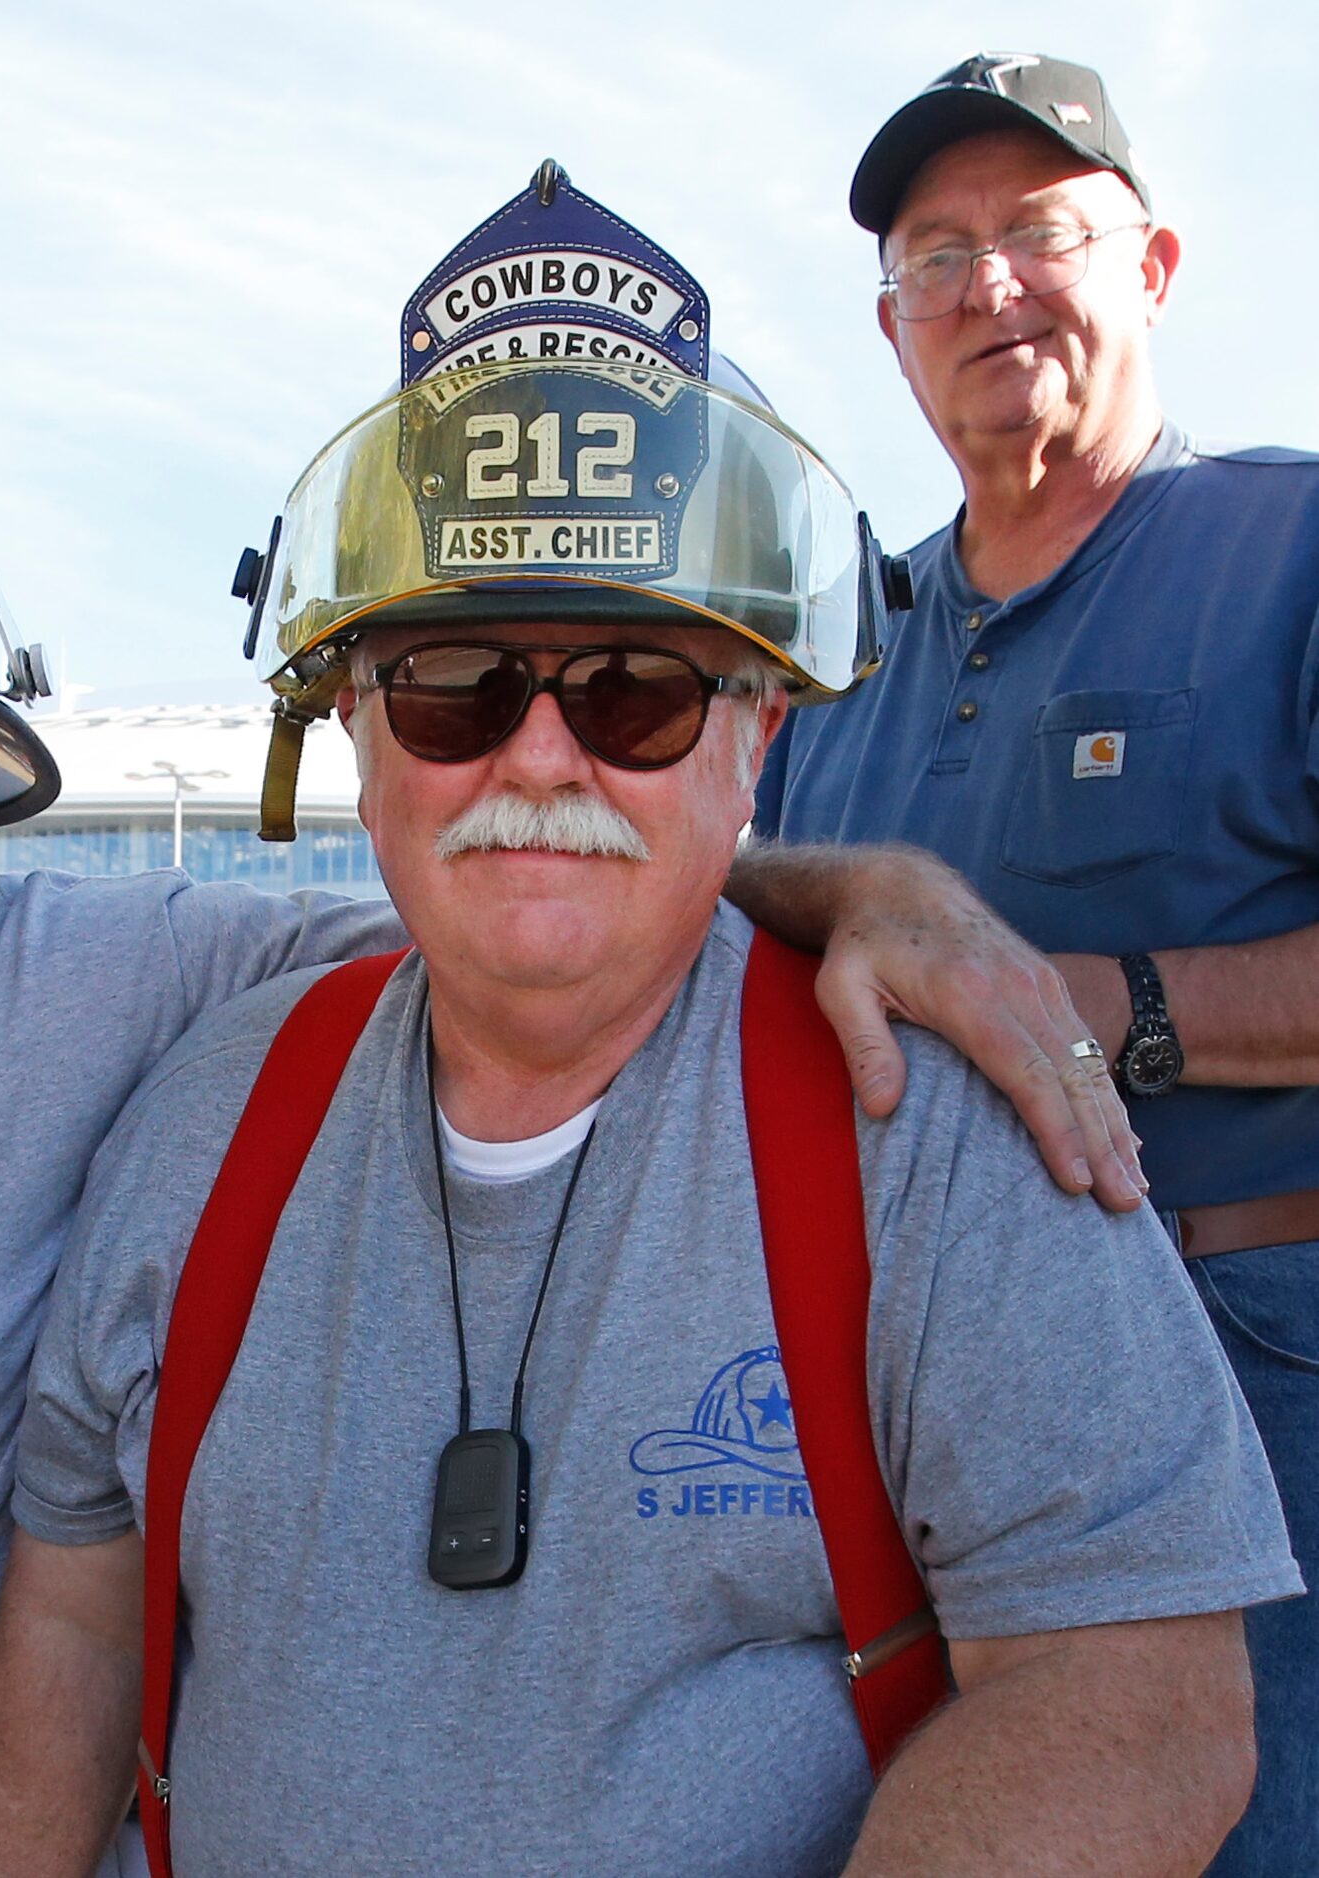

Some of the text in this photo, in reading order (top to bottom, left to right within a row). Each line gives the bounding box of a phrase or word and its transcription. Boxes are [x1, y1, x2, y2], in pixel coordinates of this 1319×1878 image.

[444, 259, 659, 323] COWBOYS
[464, 412, 637, 501] 212
[446, 525, 654, 561] ASST. CHIEF
[637, 1487, 660, 1519] S
